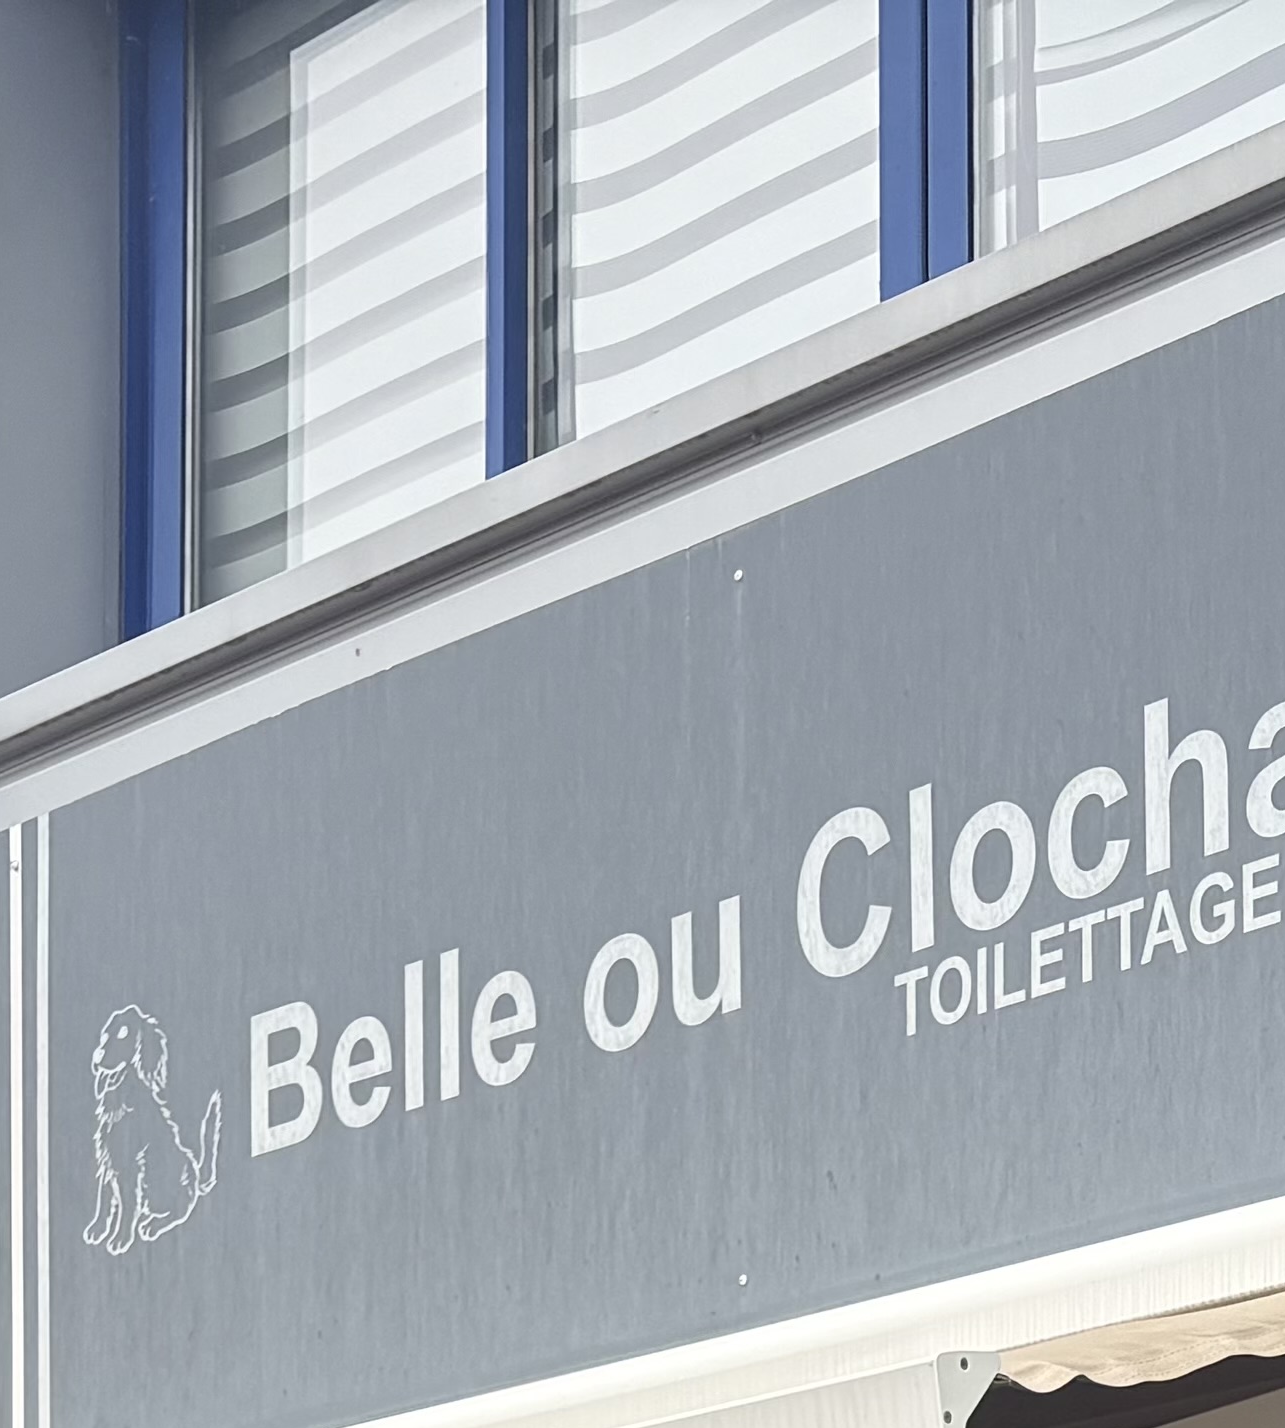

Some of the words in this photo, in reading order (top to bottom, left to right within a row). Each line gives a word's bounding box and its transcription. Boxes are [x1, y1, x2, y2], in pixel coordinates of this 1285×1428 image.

[249, 946, 538, 1159] Belle
[582, 893, 743, 1054] ou
[892, 851, 1283, 1038] TOILETTAGE
